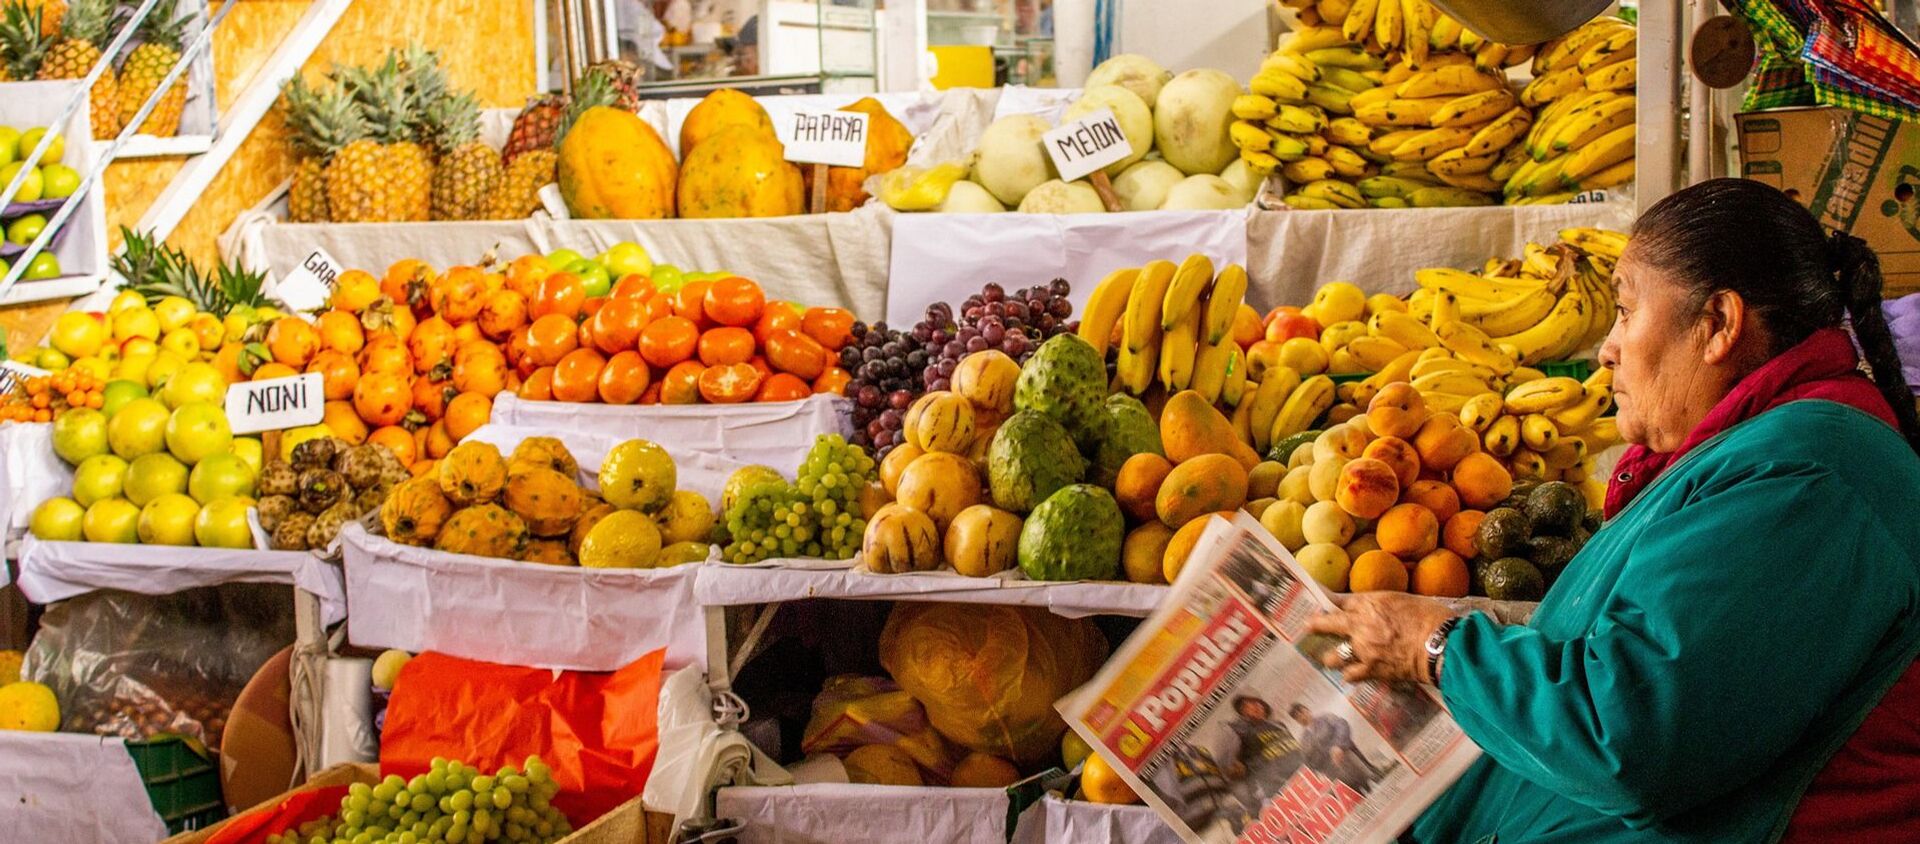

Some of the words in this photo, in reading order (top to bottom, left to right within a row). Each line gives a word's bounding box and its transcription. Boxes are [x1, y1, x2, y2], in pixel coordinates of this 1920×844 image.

[304, 251, 337, 289] GRA
[1133, 609, 1253, 734] Popular
[1236, 764, 1333, 844] RONEL
